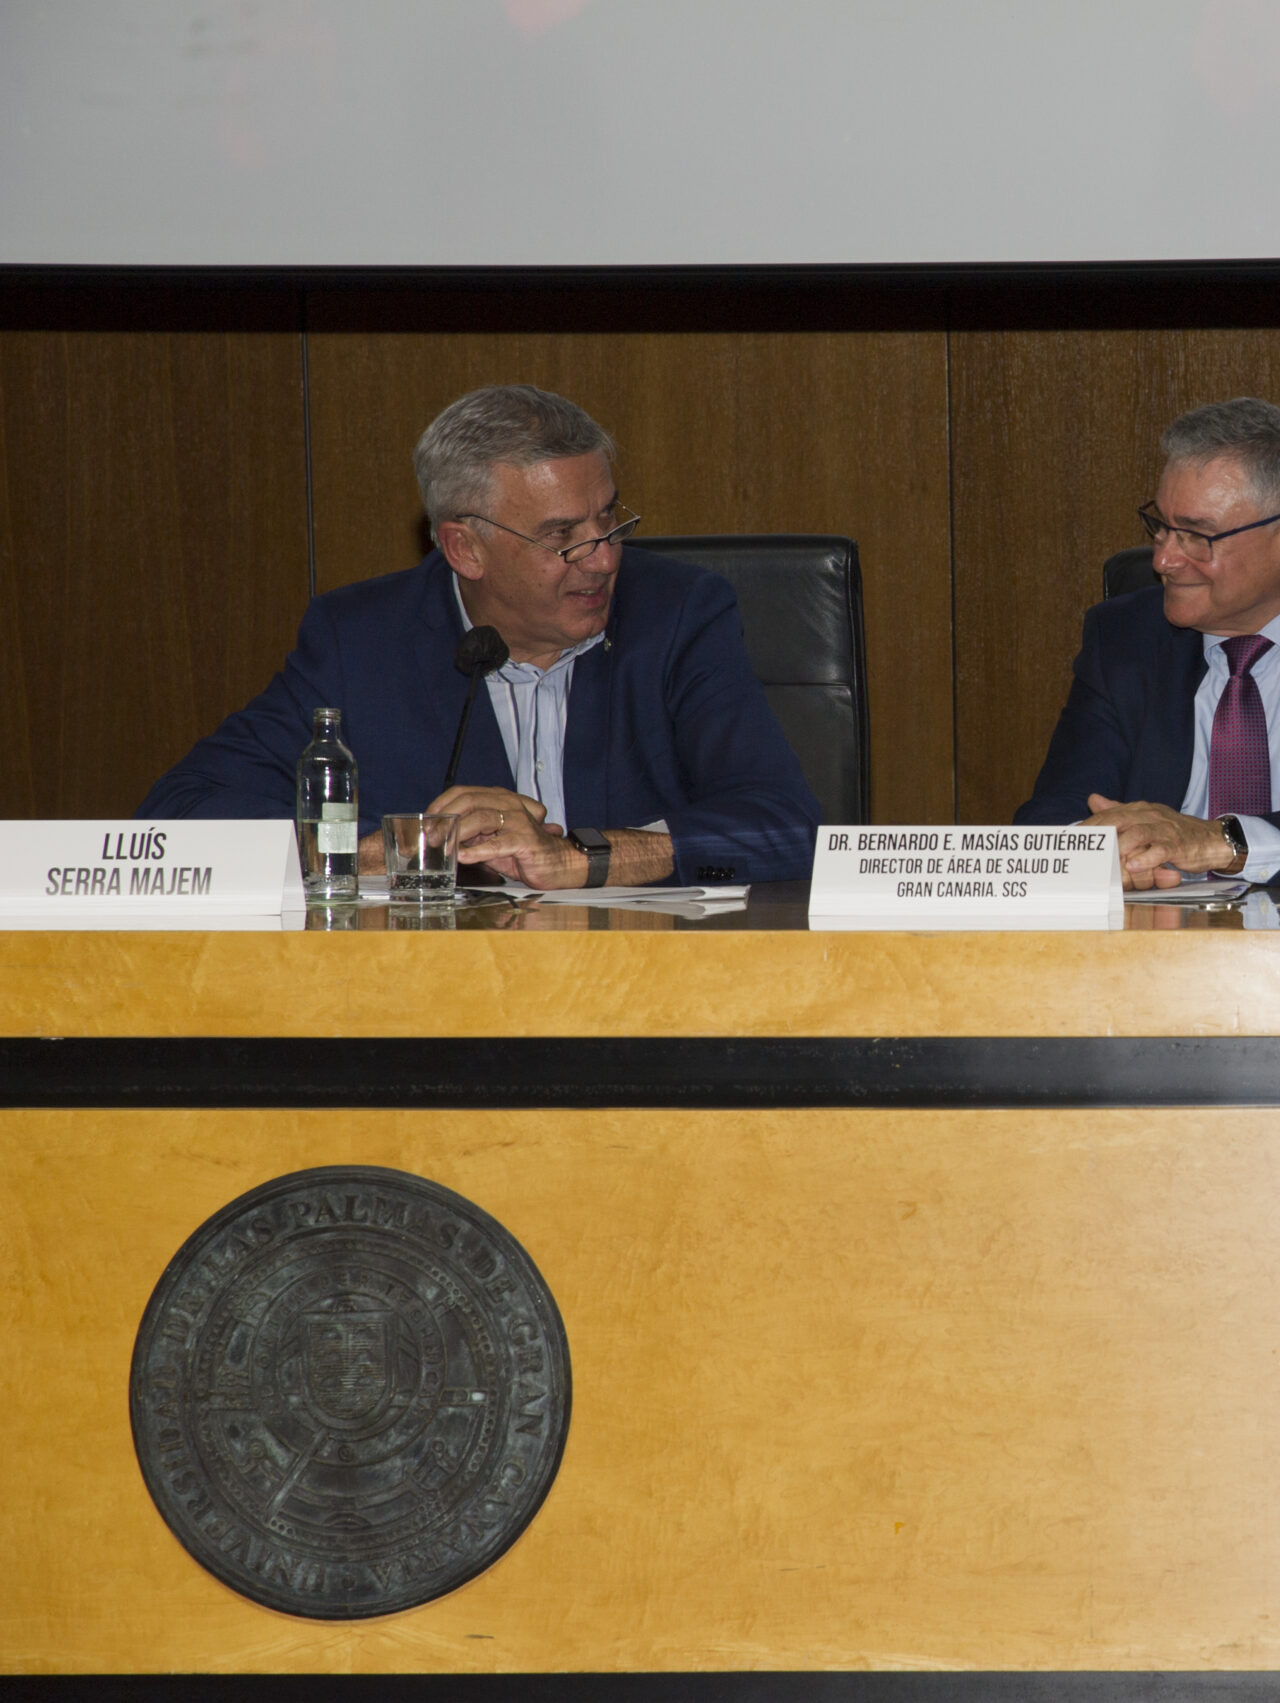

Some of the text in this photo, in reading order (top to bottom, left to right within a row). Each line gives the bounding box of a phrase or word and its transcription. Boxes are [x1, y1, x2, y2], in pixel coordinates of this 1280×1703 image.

[101, 827, 167, 860] LLUÍS
[828, 830, 1107, 851] DR. BERNARDO E. MASÍAS GUTIÉRREZ
[859, 855, 1071, 874] DIRECTOR DE ÁREA DE SALUD DE
[45, 867, 213, 896] SERRA MAJEM
[896, 881, 1028, 898] GRAN CANARIA. SCS
[289, 1193, 460, 1250] PALMAS
[509, 1319, 544, 1438] GRAN
